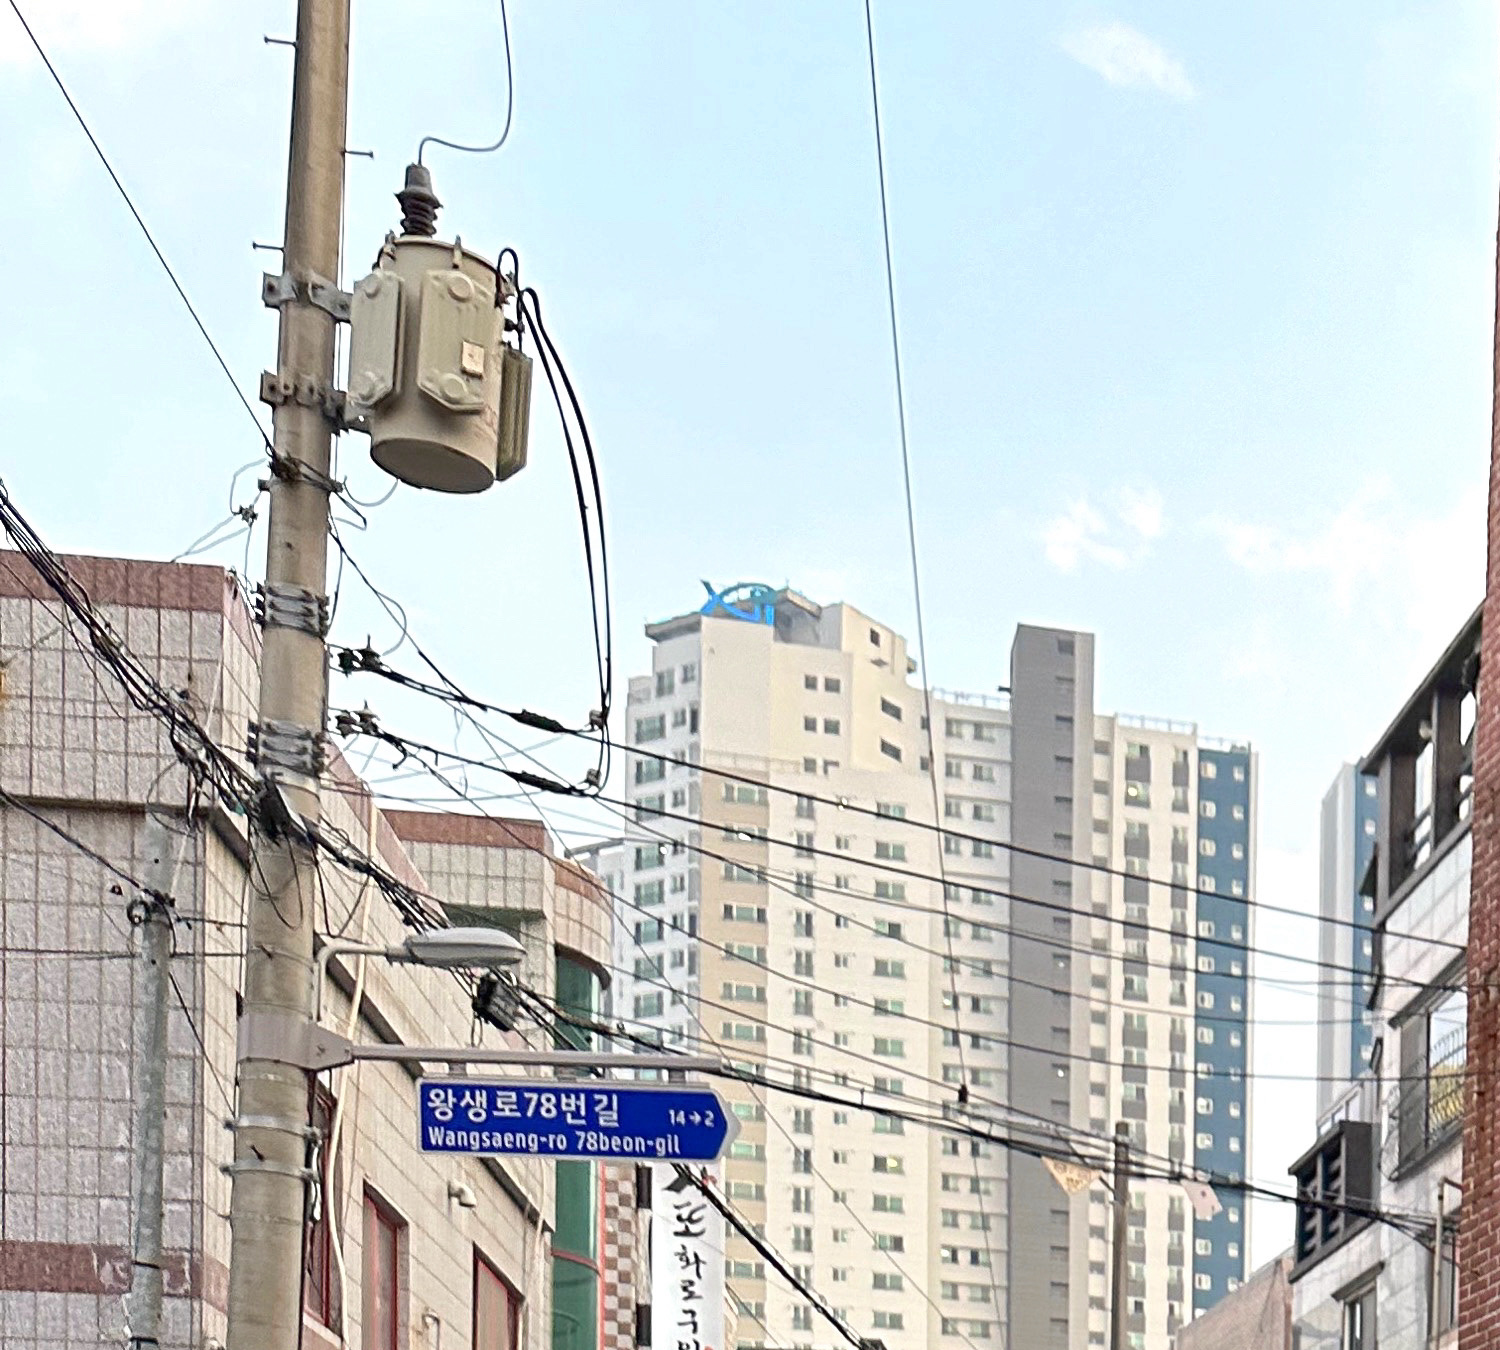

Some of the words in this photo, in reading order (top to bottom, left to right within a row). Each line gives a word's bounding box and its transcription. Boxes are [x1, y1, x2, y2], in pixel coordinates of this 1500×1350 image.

[427, 1088, 618, 1128] 왕생로78번길
[428, 1126, 567, 1152] Wangsaeng-ro
[576, 1131, 680, 1158] 78beon-gil
